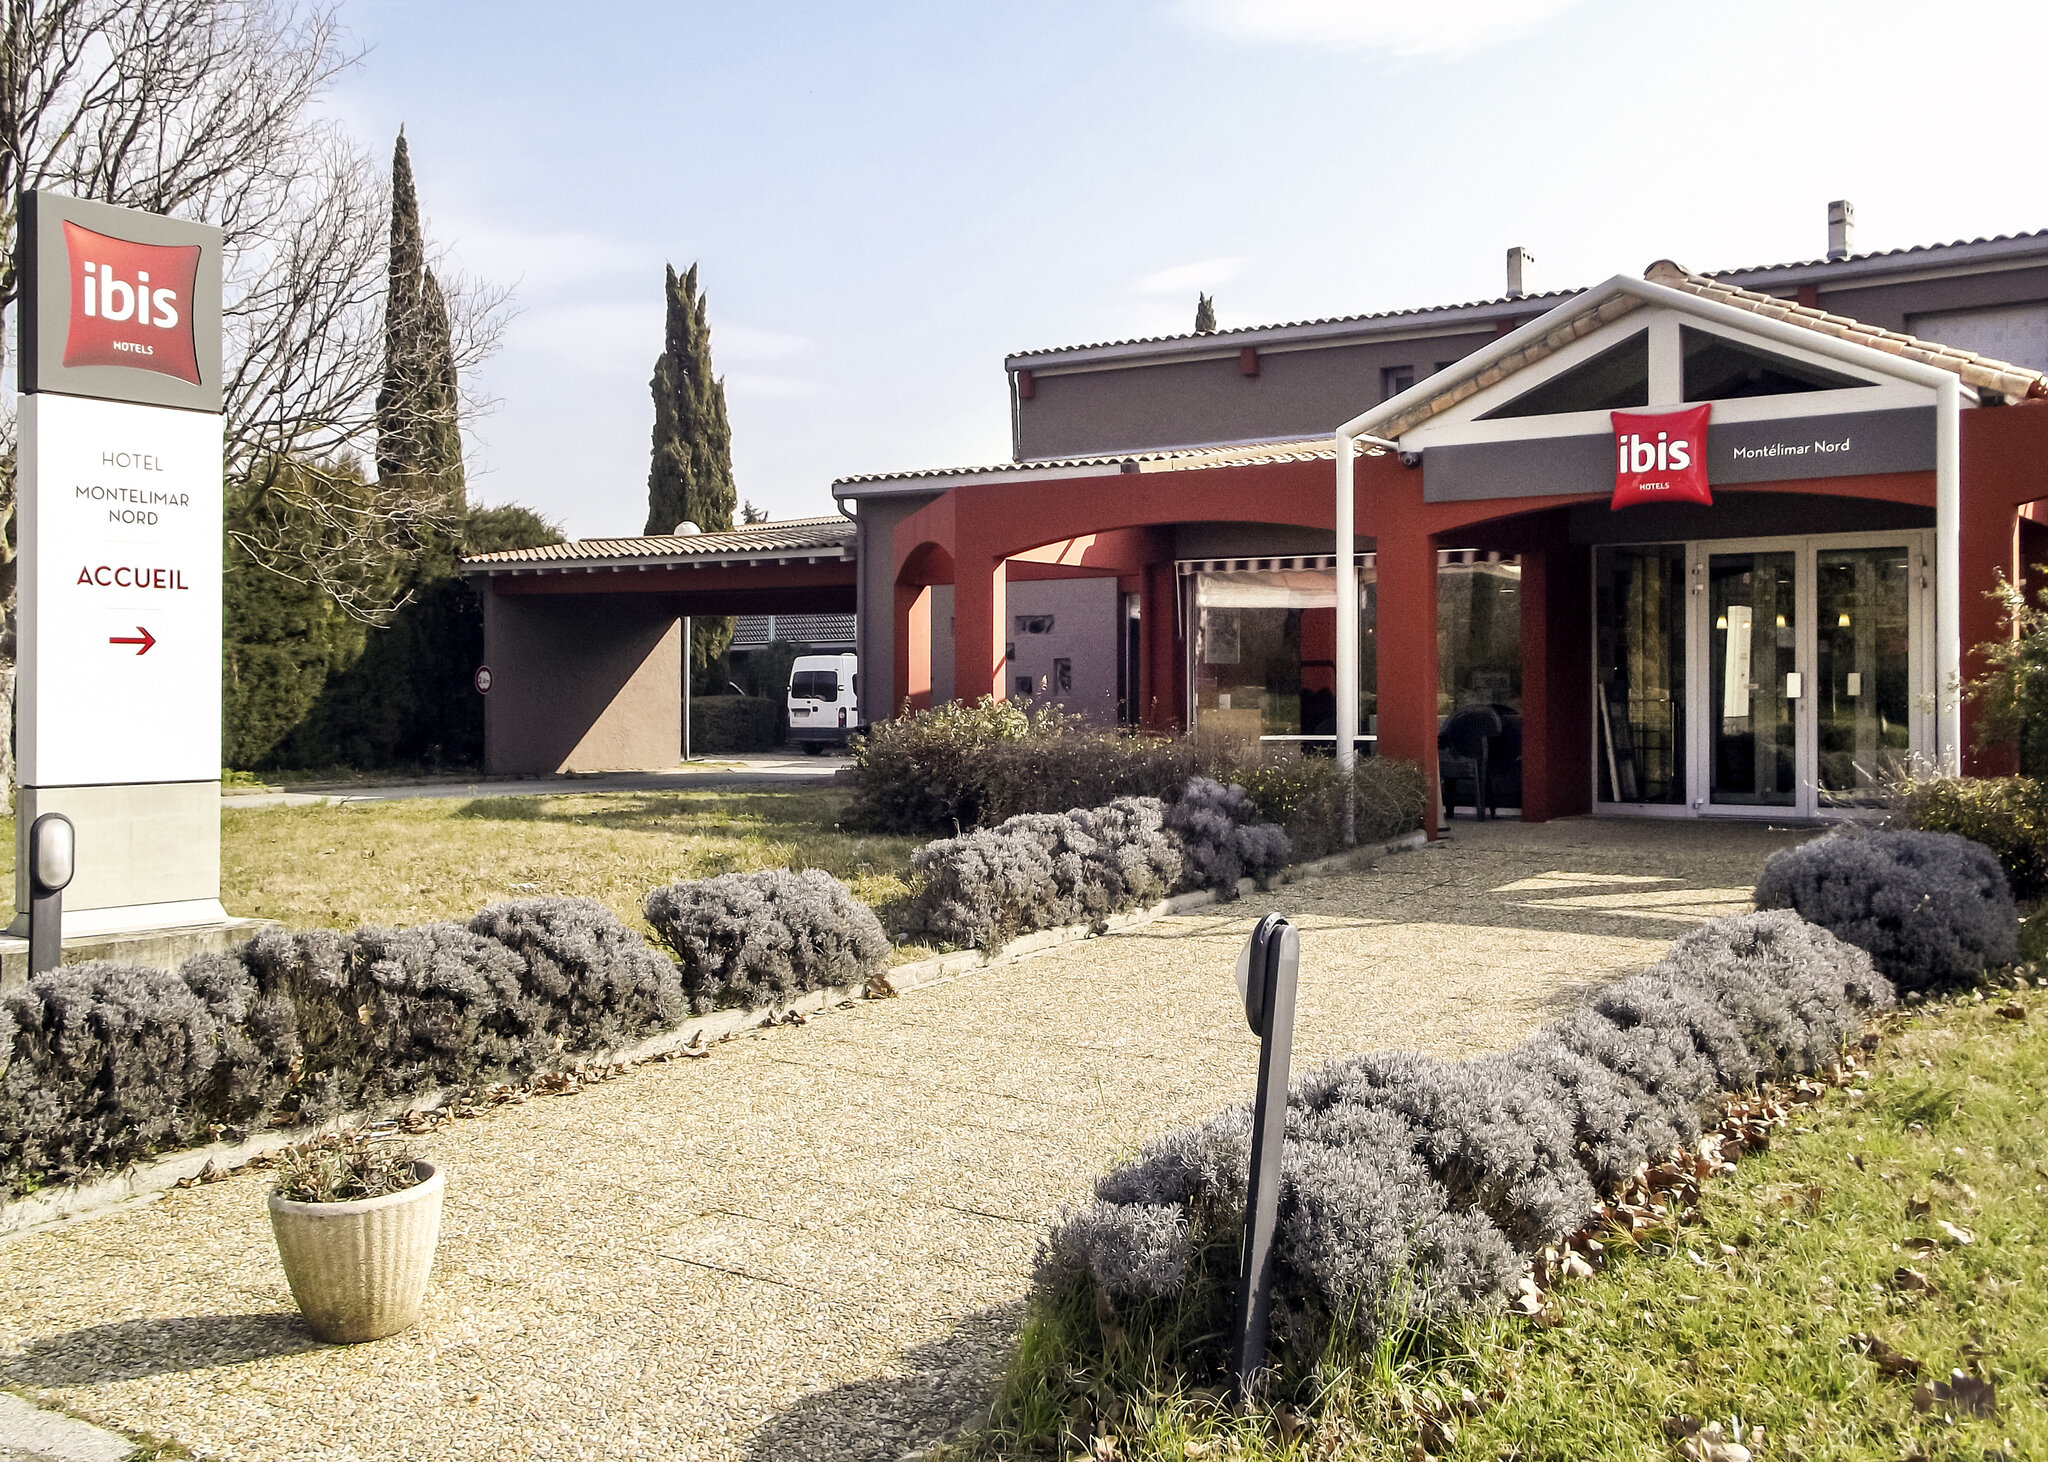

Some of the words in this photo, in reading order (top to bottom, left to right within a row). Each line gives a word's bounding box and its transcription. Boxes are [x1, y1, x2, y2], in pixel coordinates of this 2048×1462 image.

[84, 261, 179, 329] ibis
[113, 341, 154, 355] HOTELS
[1619, 431, 1691, 474] ibis
[1733, 442, 1811, 460] Montélimar
[1814, 438, 1851, 453] Nord
[102, 451, 164, 472] HOTEL
[75, 485, 190, 507] MONTELIMAR
[1639, 482, 1670, 491] HOTELS
[109, 509, 159, 526] NORD
[76, 565, 189, 590] ACCUEIL
